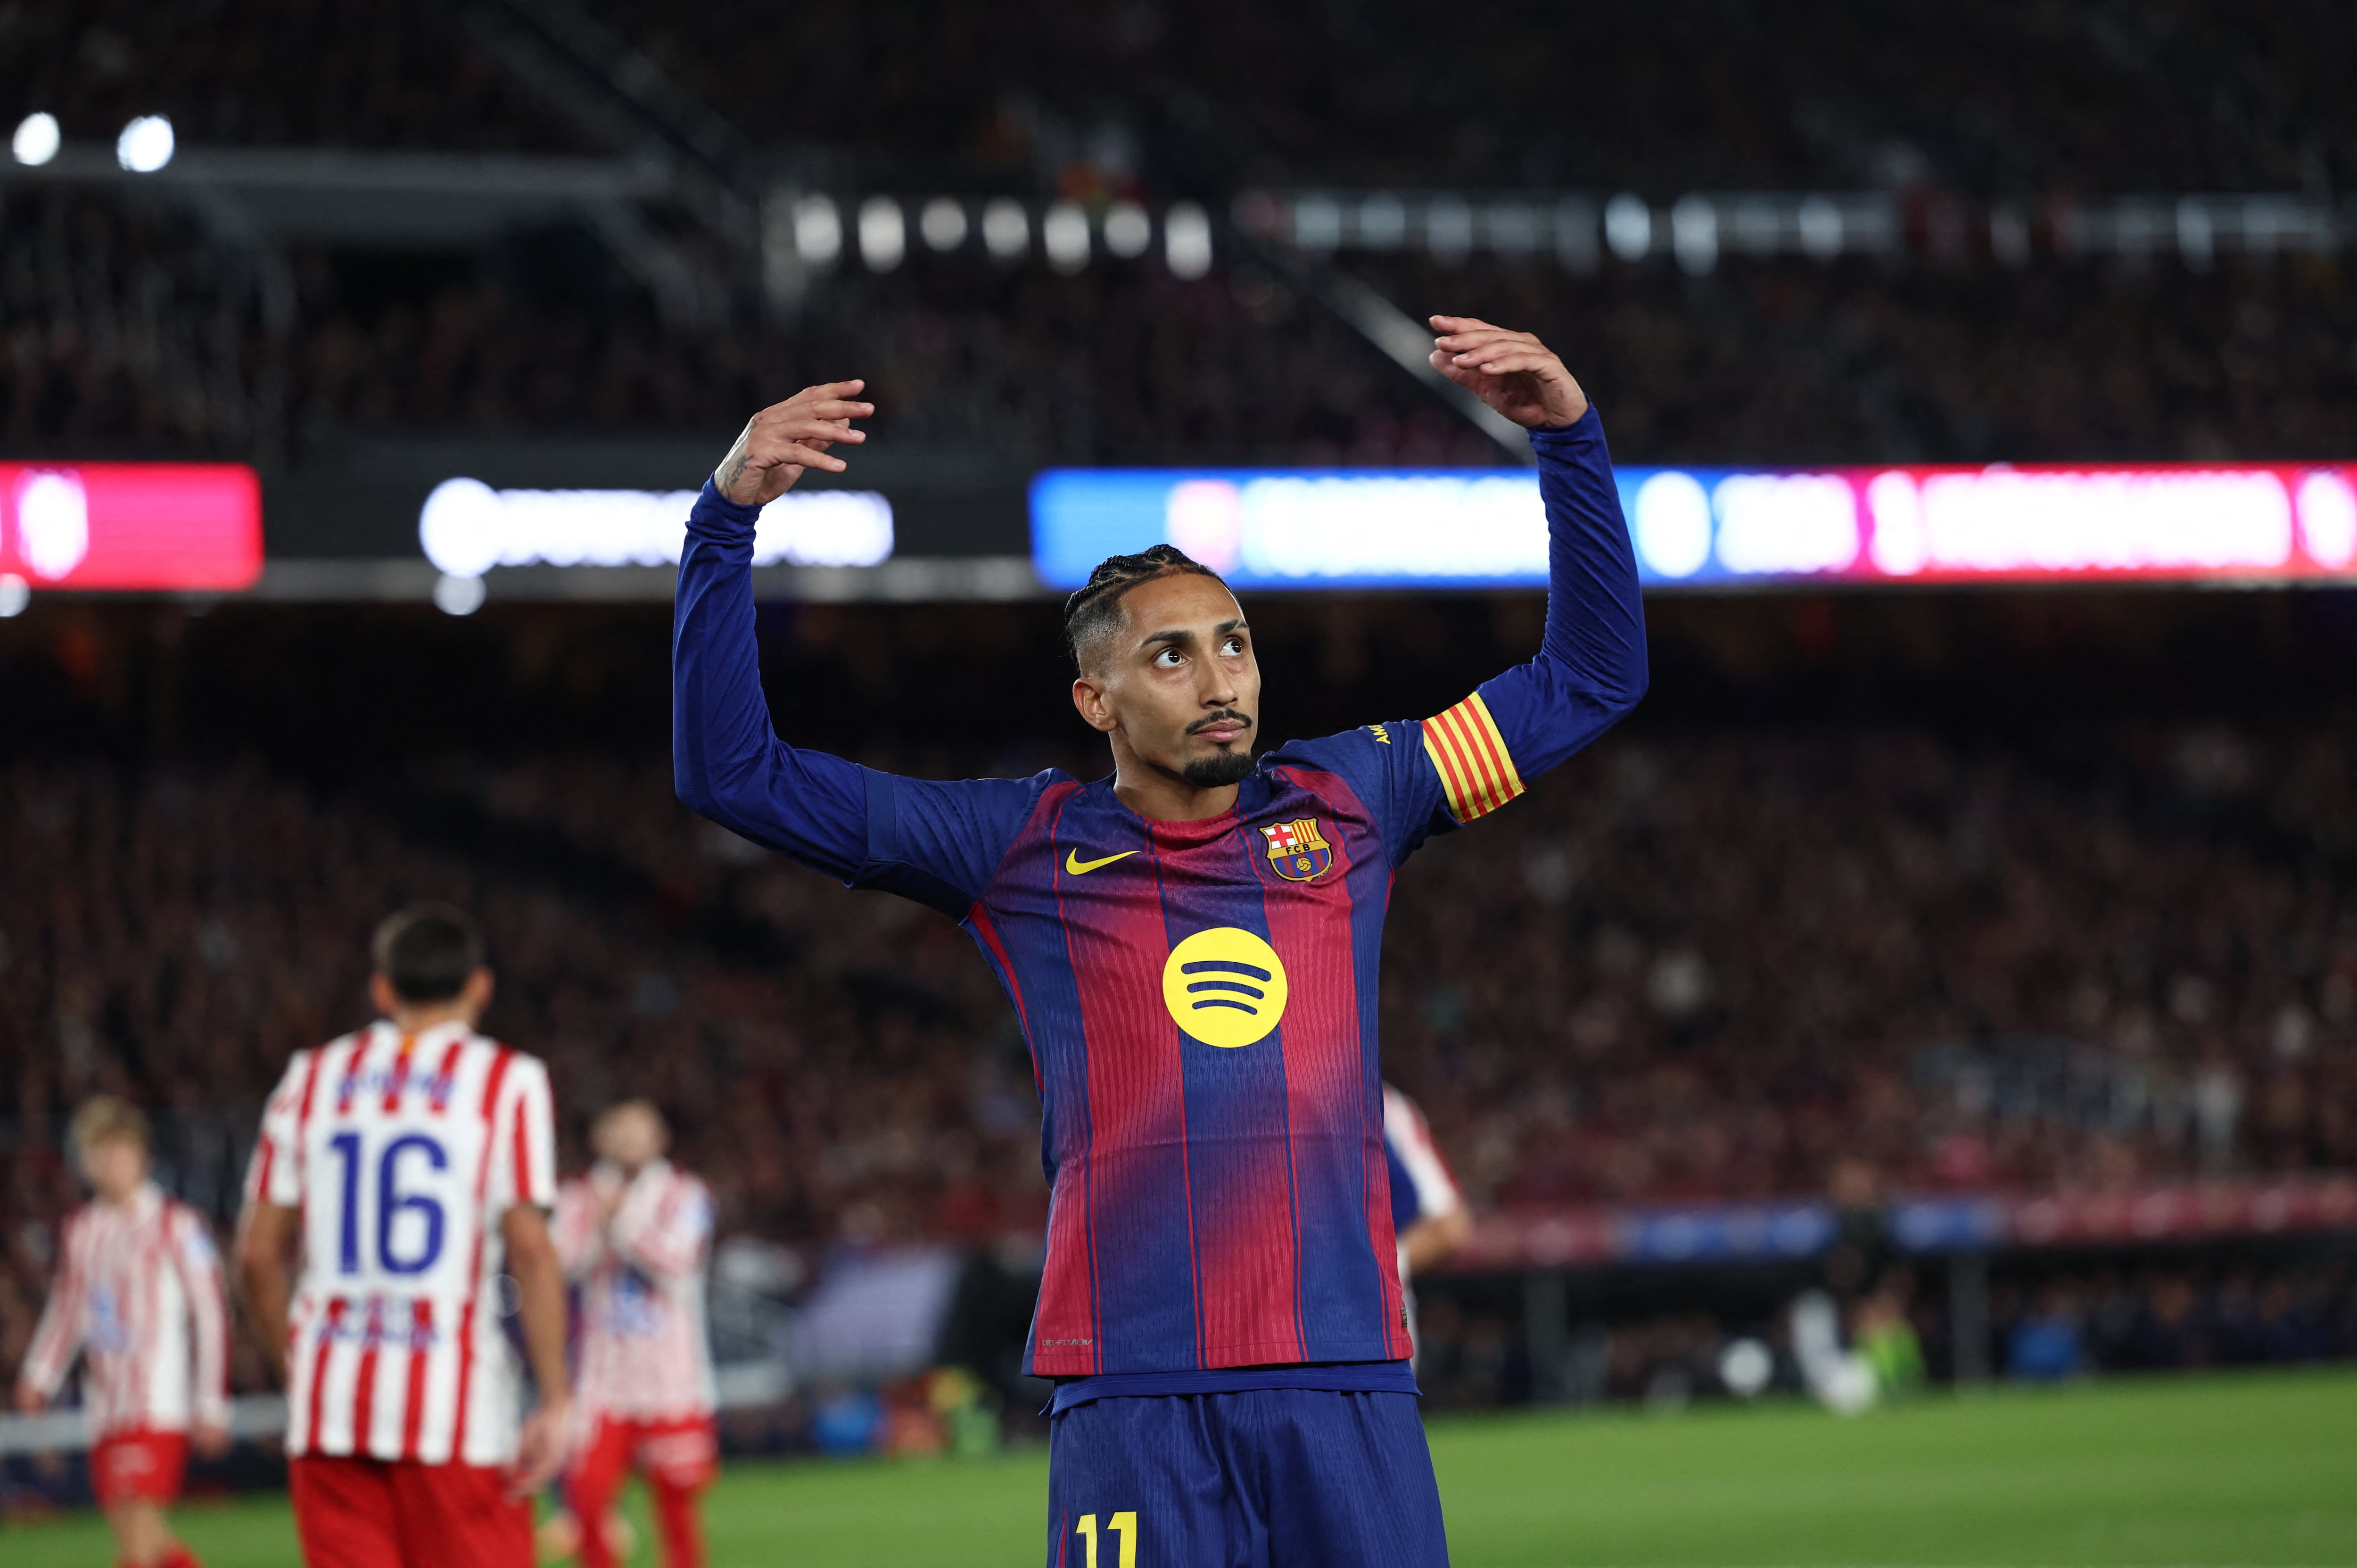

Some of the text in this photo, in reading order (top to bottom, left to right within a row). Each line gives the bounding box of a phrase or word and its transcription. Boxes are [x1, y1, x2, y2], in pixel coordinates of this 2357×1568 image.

[1286, 843, 1310, 855] FCB
[330, 1131, 449, 1276] 16
[1075, 1511, 1137, 1568] 11
